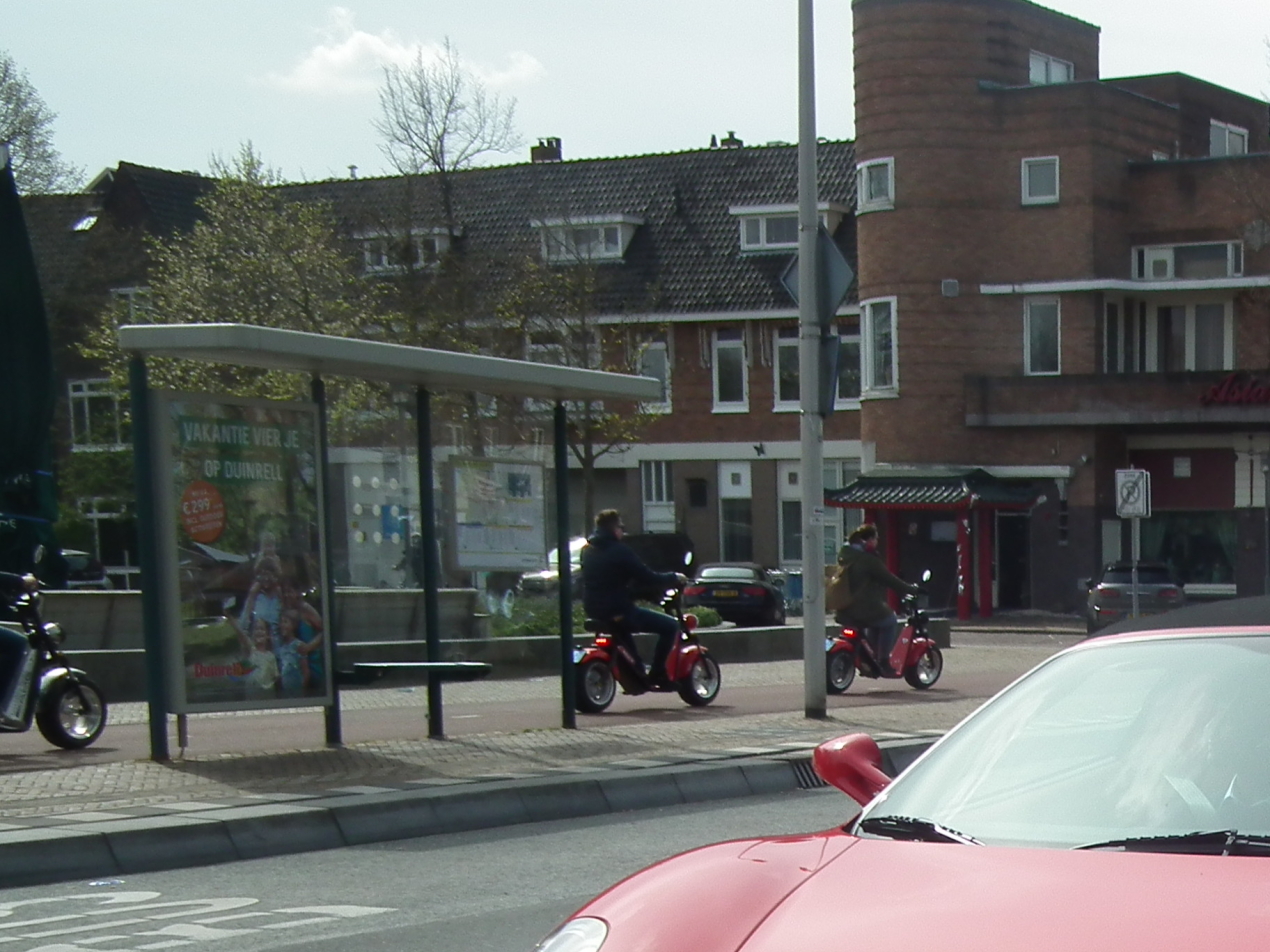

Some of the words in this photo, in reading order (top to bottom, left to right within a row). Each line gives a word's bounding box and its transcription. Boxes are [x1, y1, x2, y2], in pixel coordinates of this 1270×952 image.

[183, 421, 250, 445] VAKANTIE
[252, 425, 281, 447] VIER
[283, 430, 299, 448] JE
[204, 459, 221, 478] OP
[223, 460, 283, 481] DUINRELL
